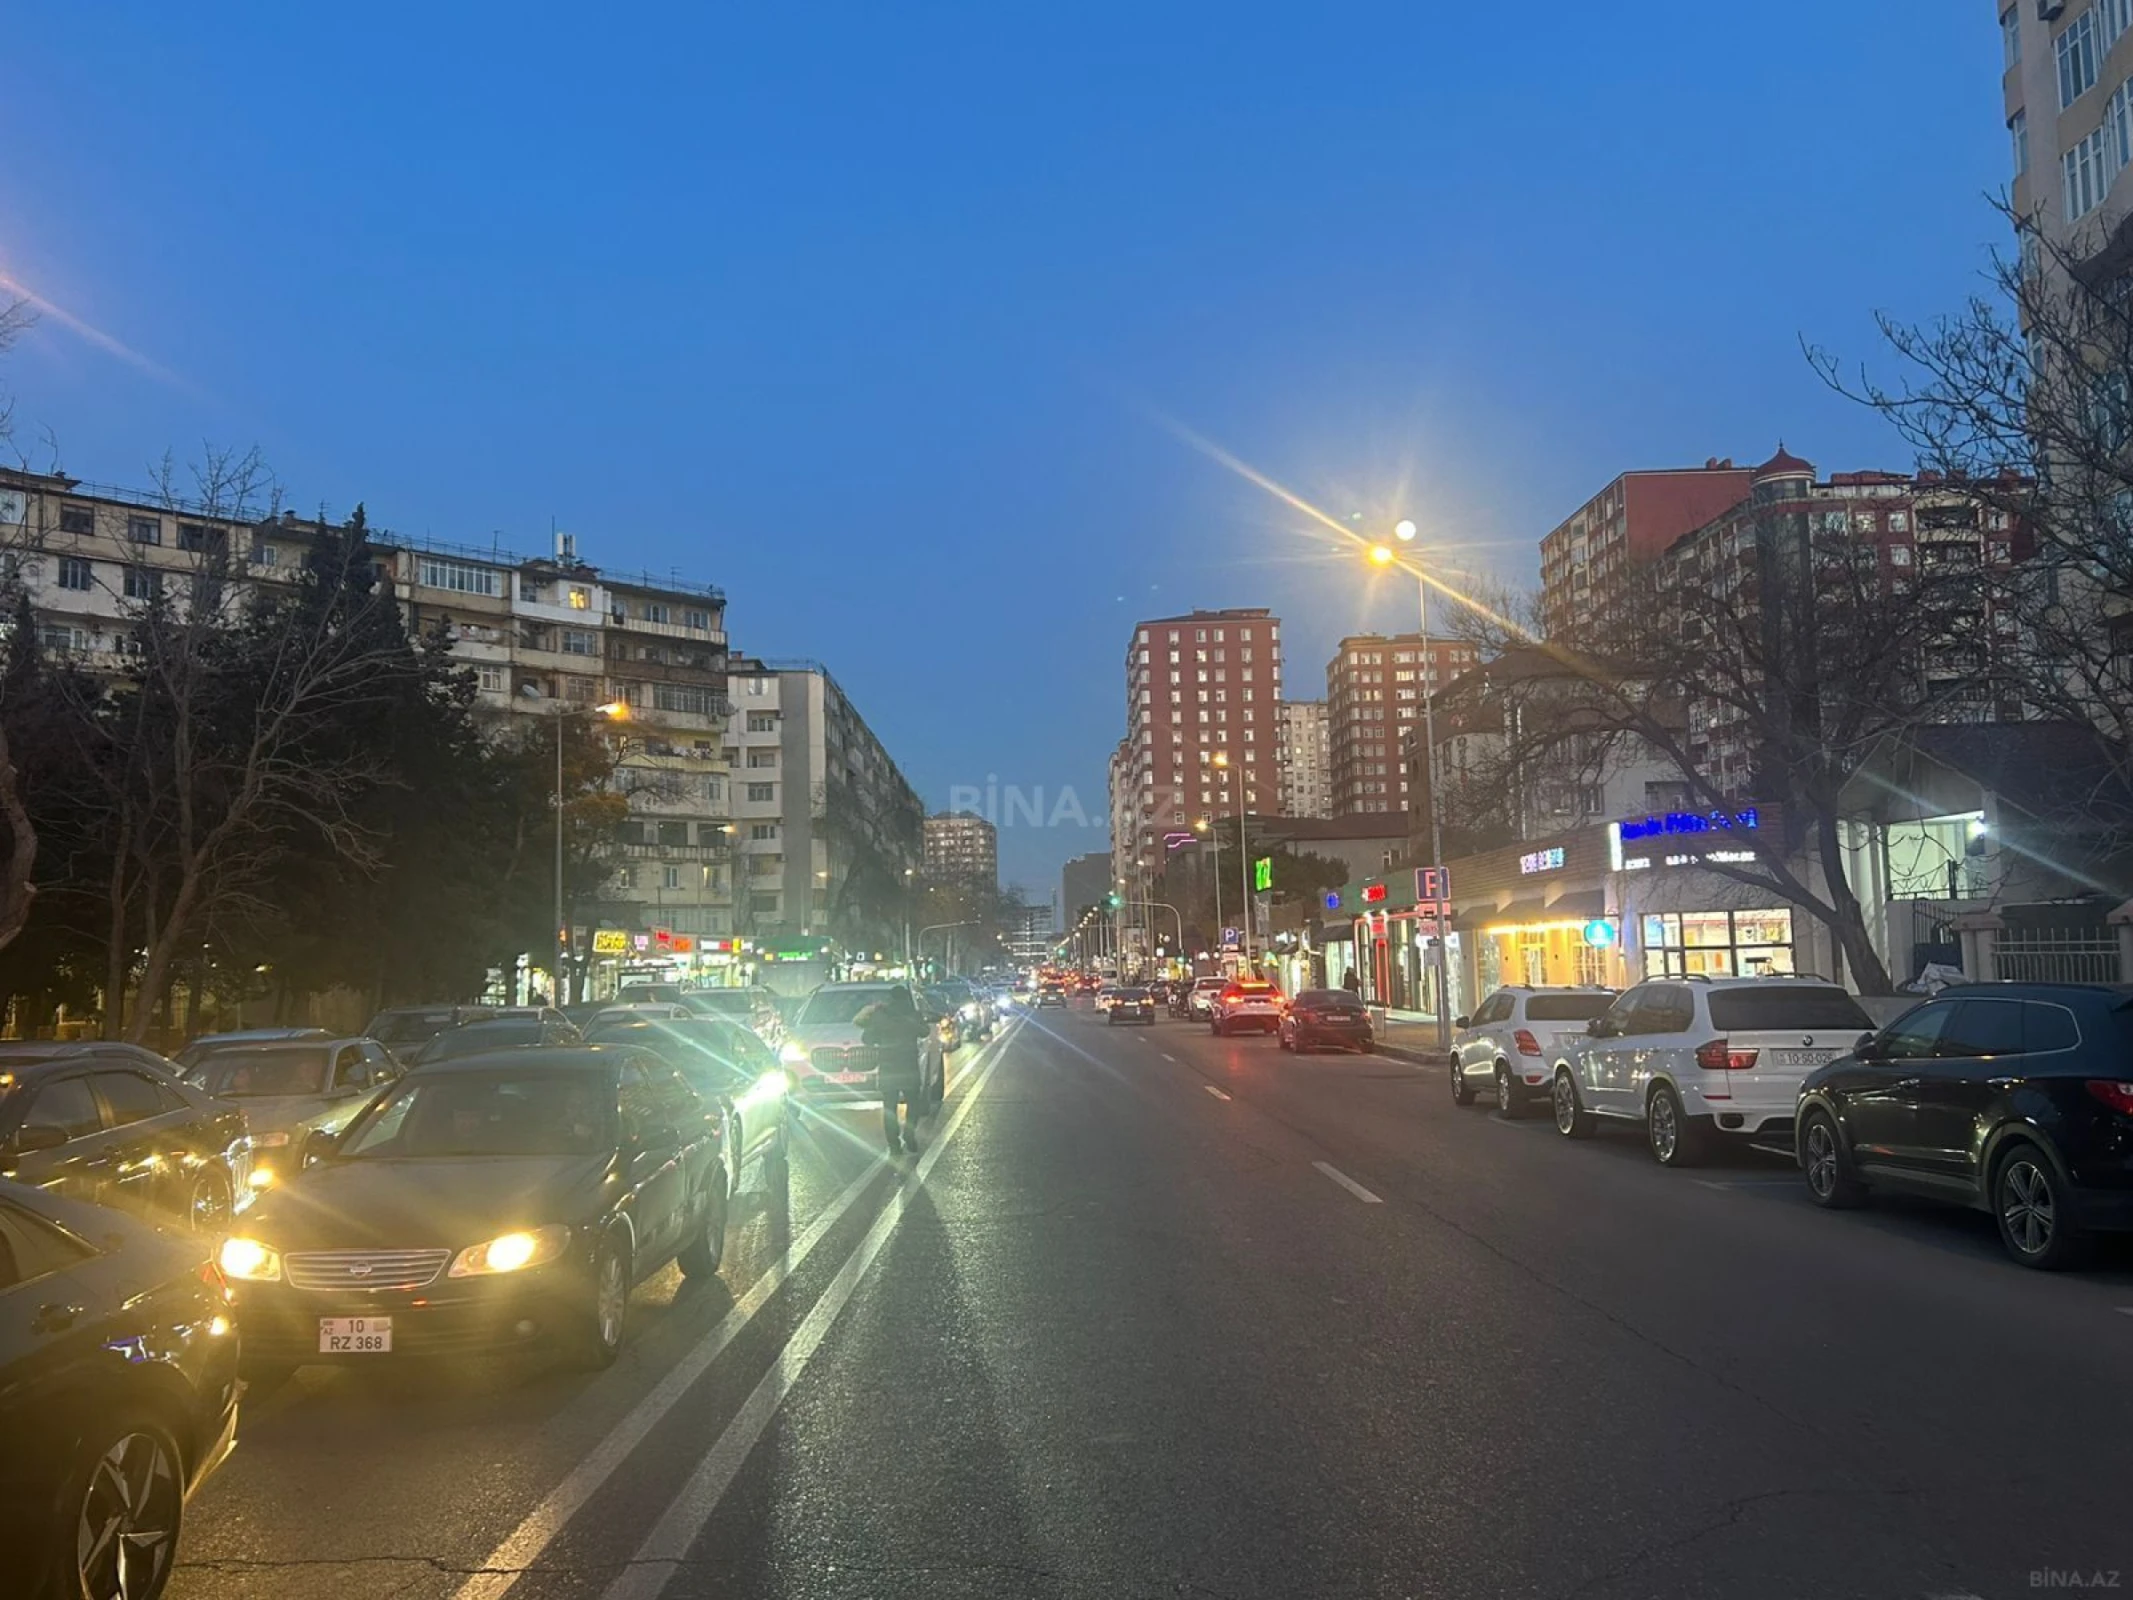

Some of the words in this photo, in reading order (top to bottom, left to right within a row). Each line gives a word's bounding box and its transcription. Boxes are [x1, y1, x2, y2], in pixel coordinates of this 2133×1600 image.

[1225, 929, 1235, 942] P
[349, 1320, 364, 1333] 10
[330, 1336, 351, 1350] RZ
[356, 1336, 383, 1350] 368
